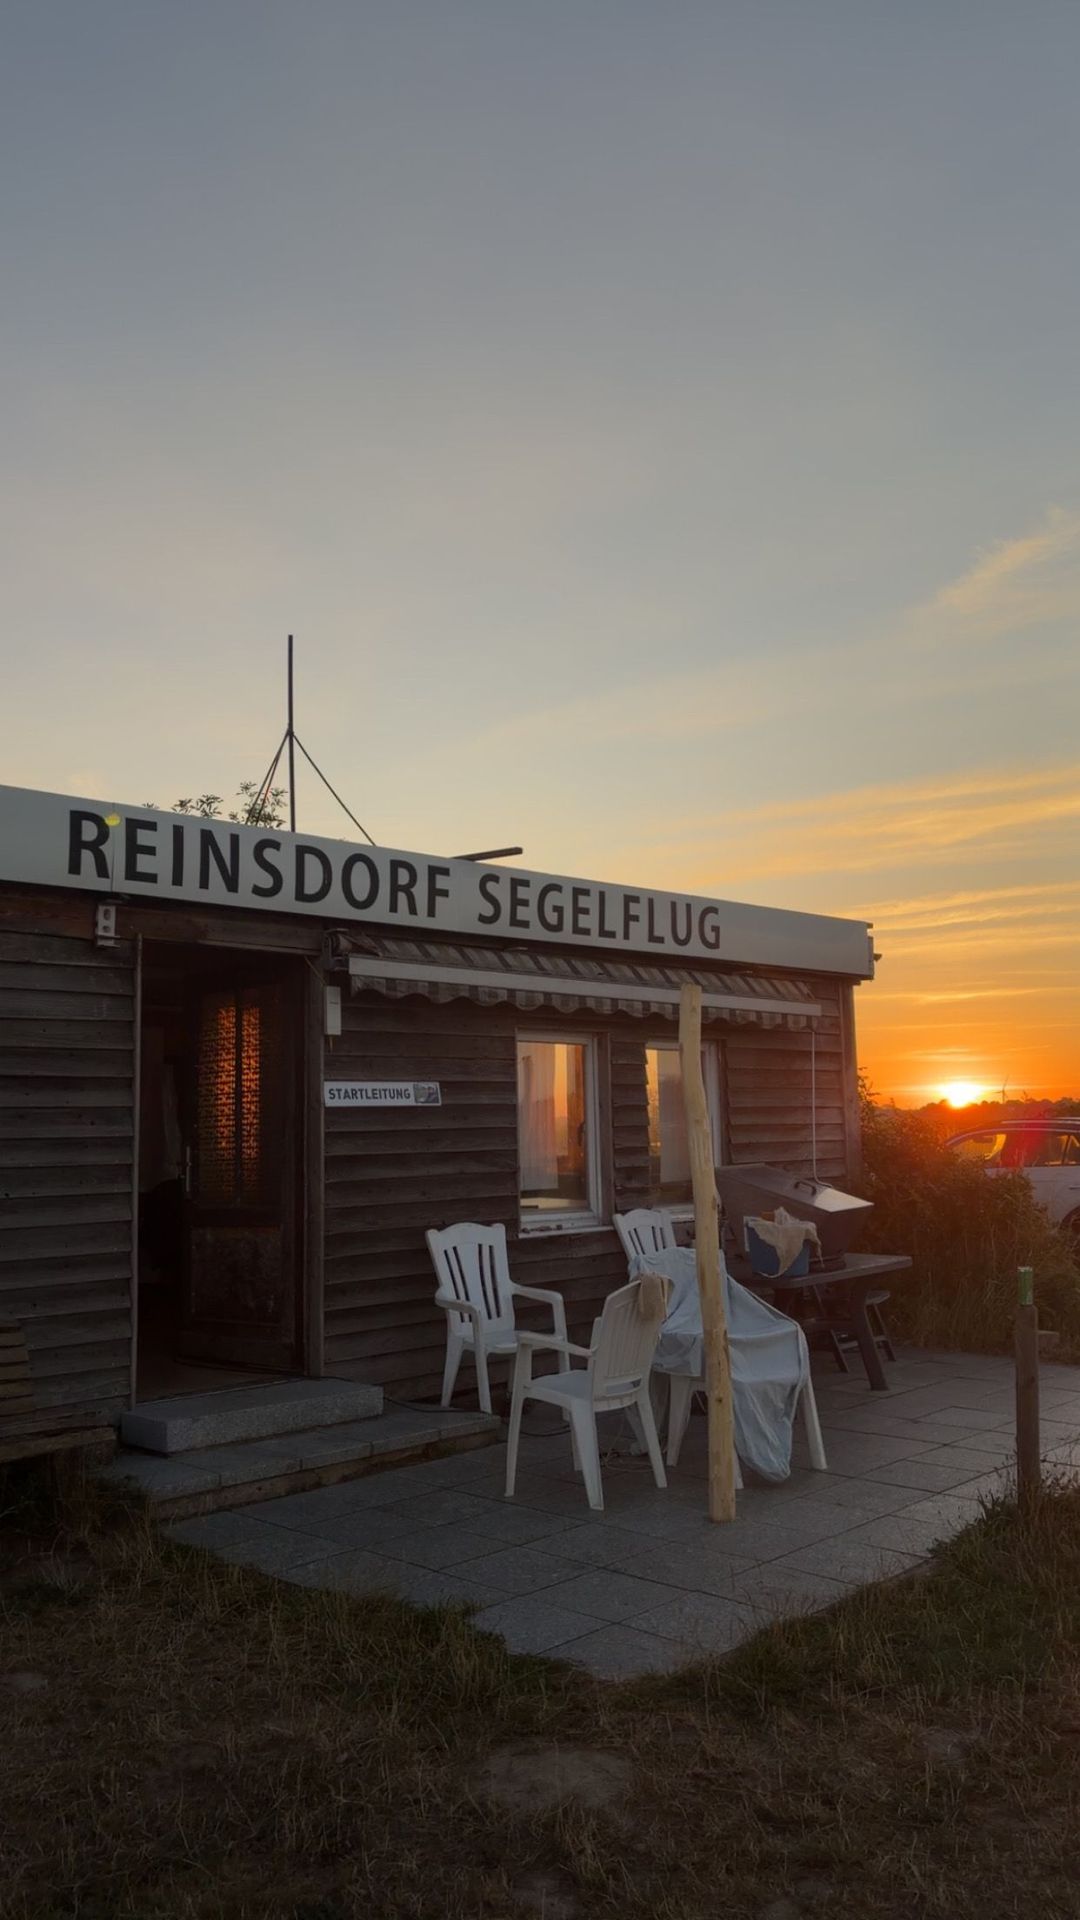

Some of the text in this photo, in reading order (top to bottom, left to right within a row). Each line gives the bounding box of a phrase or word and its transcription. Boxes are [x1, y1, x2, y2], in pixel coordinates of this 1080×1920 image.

[67, 809, 721, 950] REINSDORF SEGELFLUG
[328, 1088, 411, 1100] STARTLEITUNG
